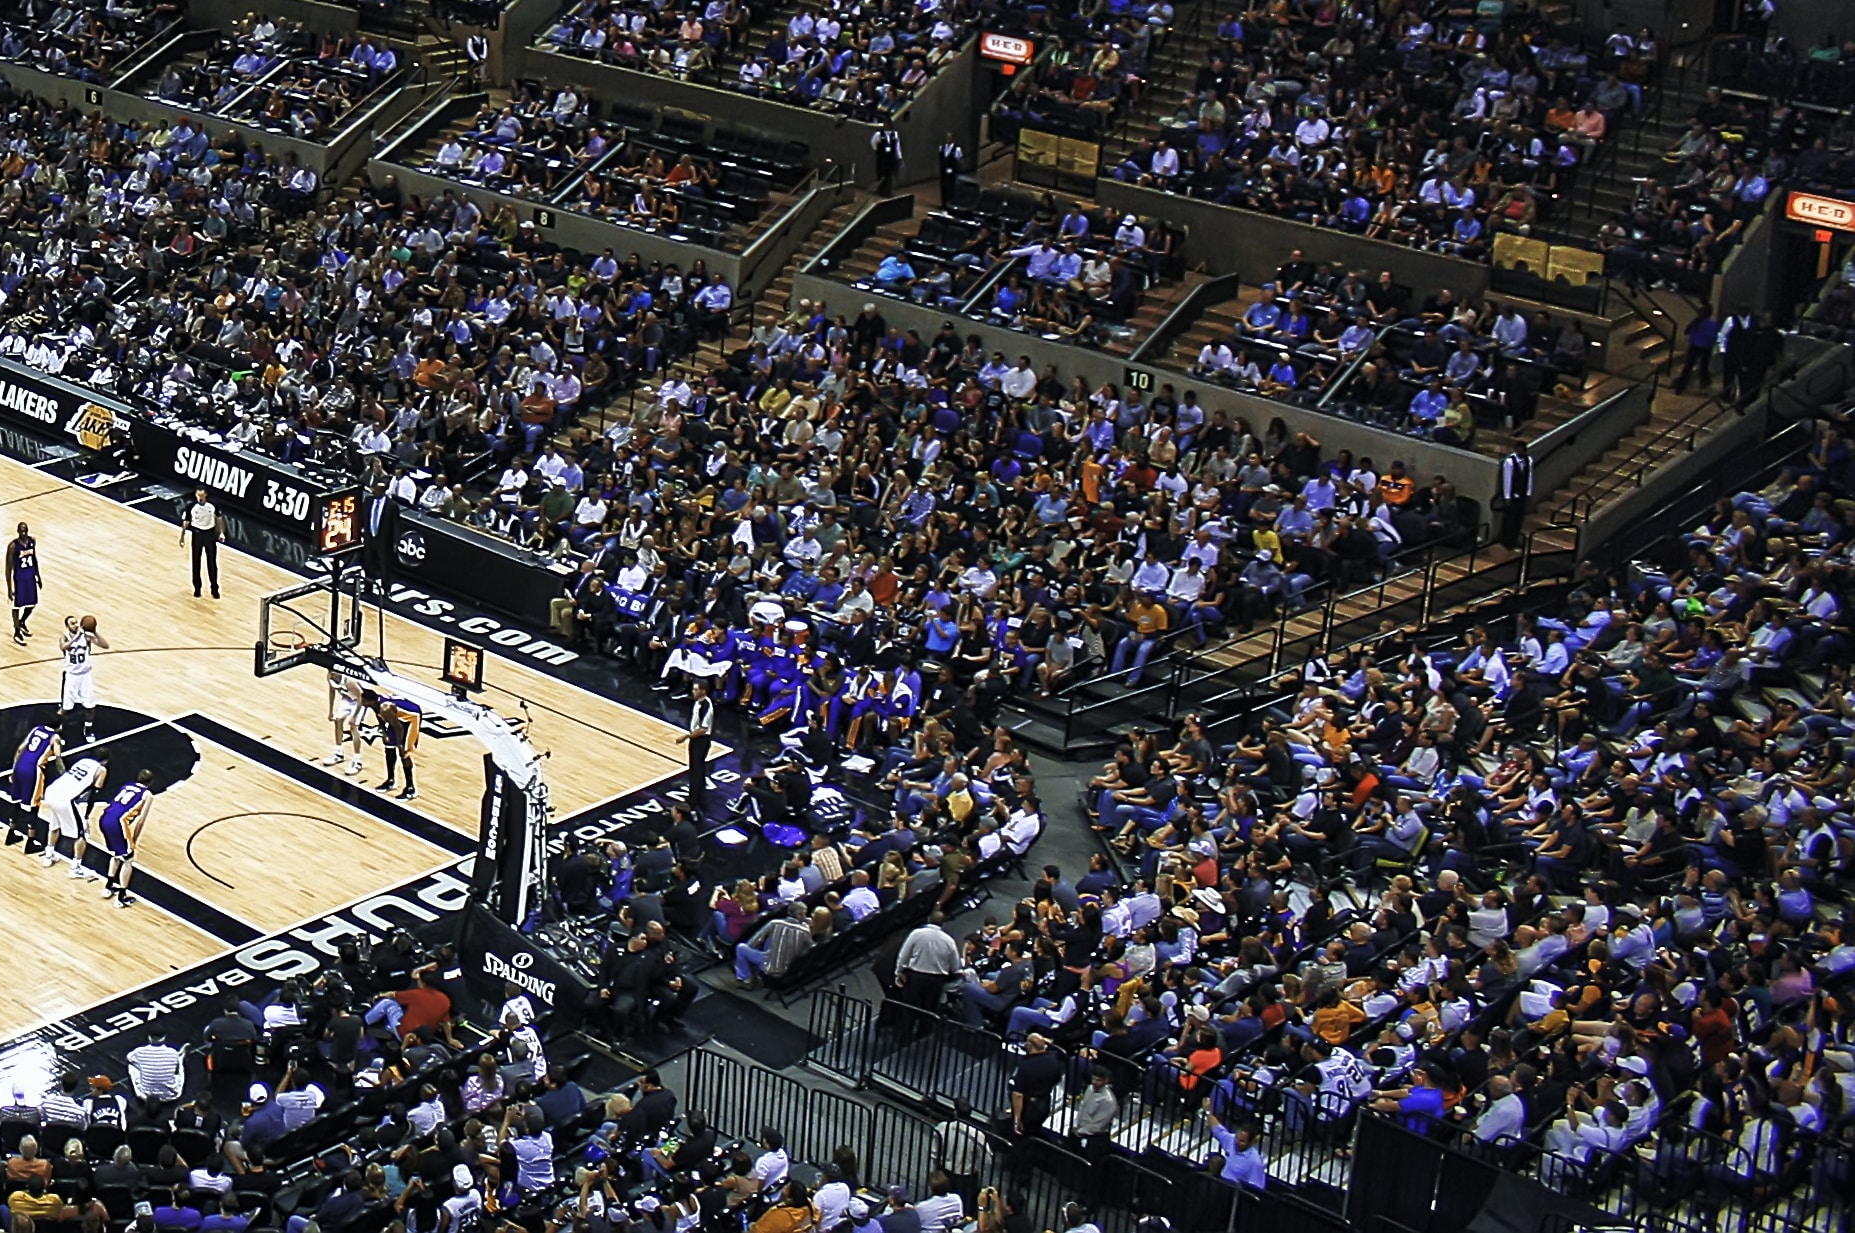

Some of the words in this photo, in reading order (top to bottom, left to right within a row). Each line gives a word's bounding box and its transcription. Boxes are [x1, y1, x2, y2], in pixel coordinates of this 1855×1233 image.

[1801, 201, 1844, 219] H-E-B
[1130, 372, 1149, 389] 10
[175, 446, 254, 499] SUNDAY
[263, 479, 310, 522] 3:30
[325, 518, 352, 549] 24
[397, 537, 426, 559] abc
[20, 555, 33, 568] 24
[482, 951, 556, 1007] SPALDING
